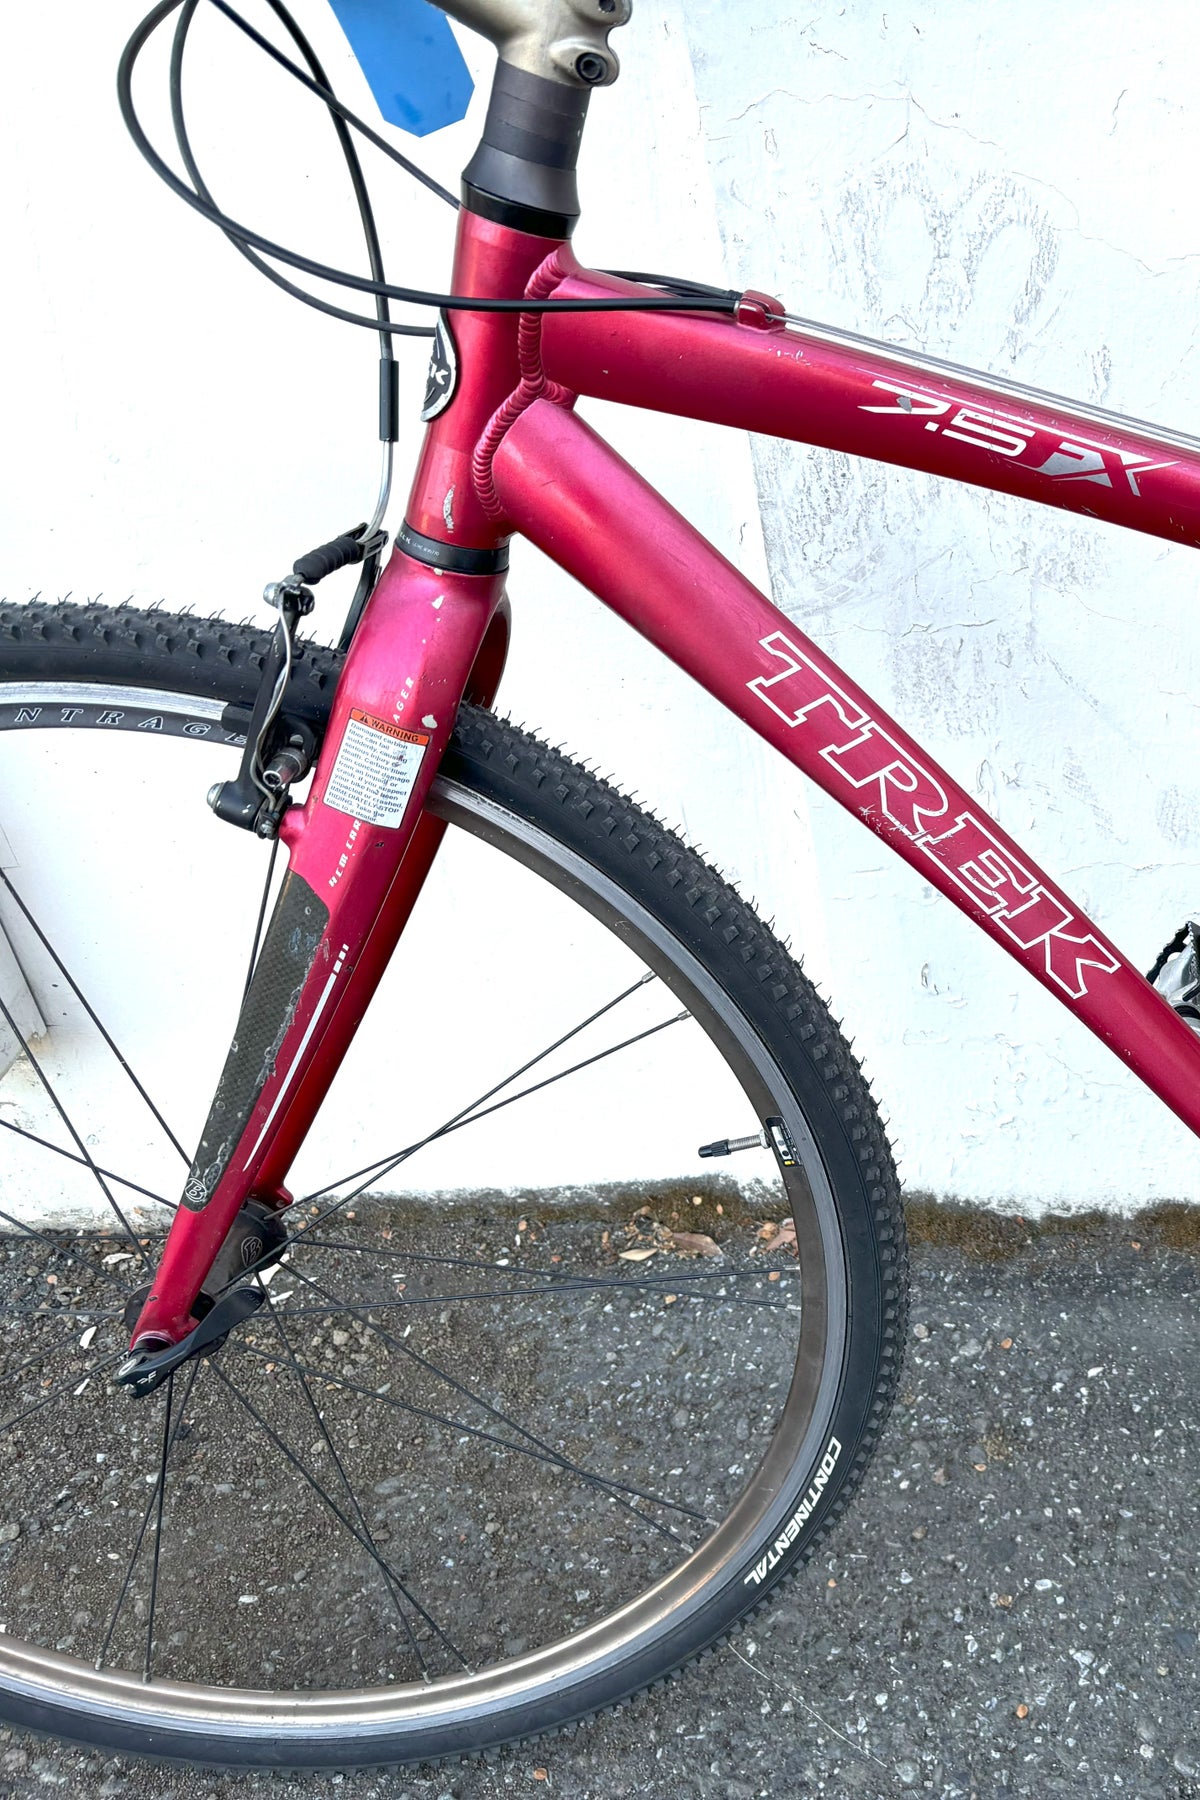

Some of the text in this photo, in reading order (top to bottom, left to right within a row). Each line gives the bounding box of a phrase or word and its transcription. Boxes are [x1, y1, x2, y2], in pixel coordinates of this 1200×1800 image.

[369, 719, 420, 743] WARNING
[746, 630, 1122, 1000] TREK
[744, 1436, 842, 1585] CONTINENTAL
